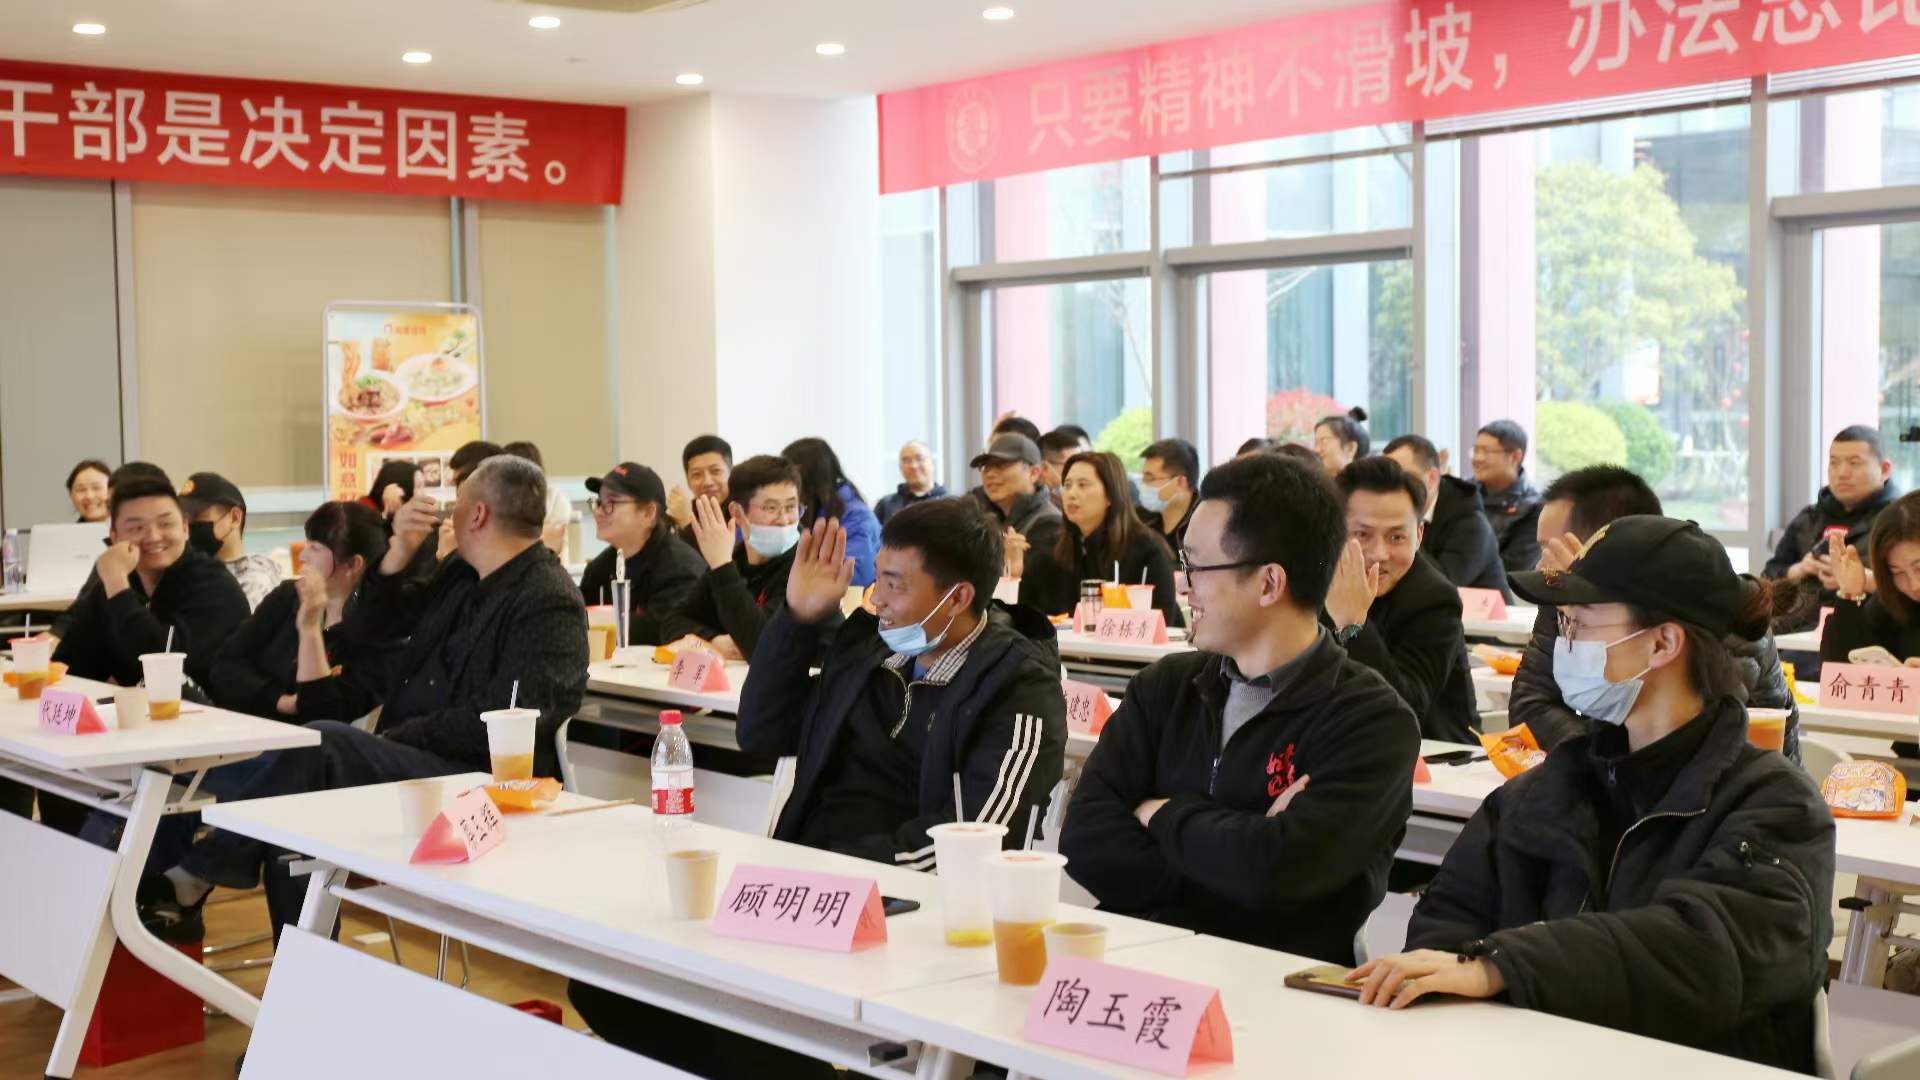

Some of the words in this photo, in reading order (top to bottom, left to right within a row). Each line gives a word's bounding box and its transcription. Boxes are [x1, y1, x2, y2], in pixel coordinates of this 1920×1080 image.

[0, 79, 566, 185] 干部是决定因素。
[1828, 672, 1910, 704] 俞青青
[728, 882, 851, 928] 顾明明
[1044, 977, 1183, 1051] 陶玉霞
